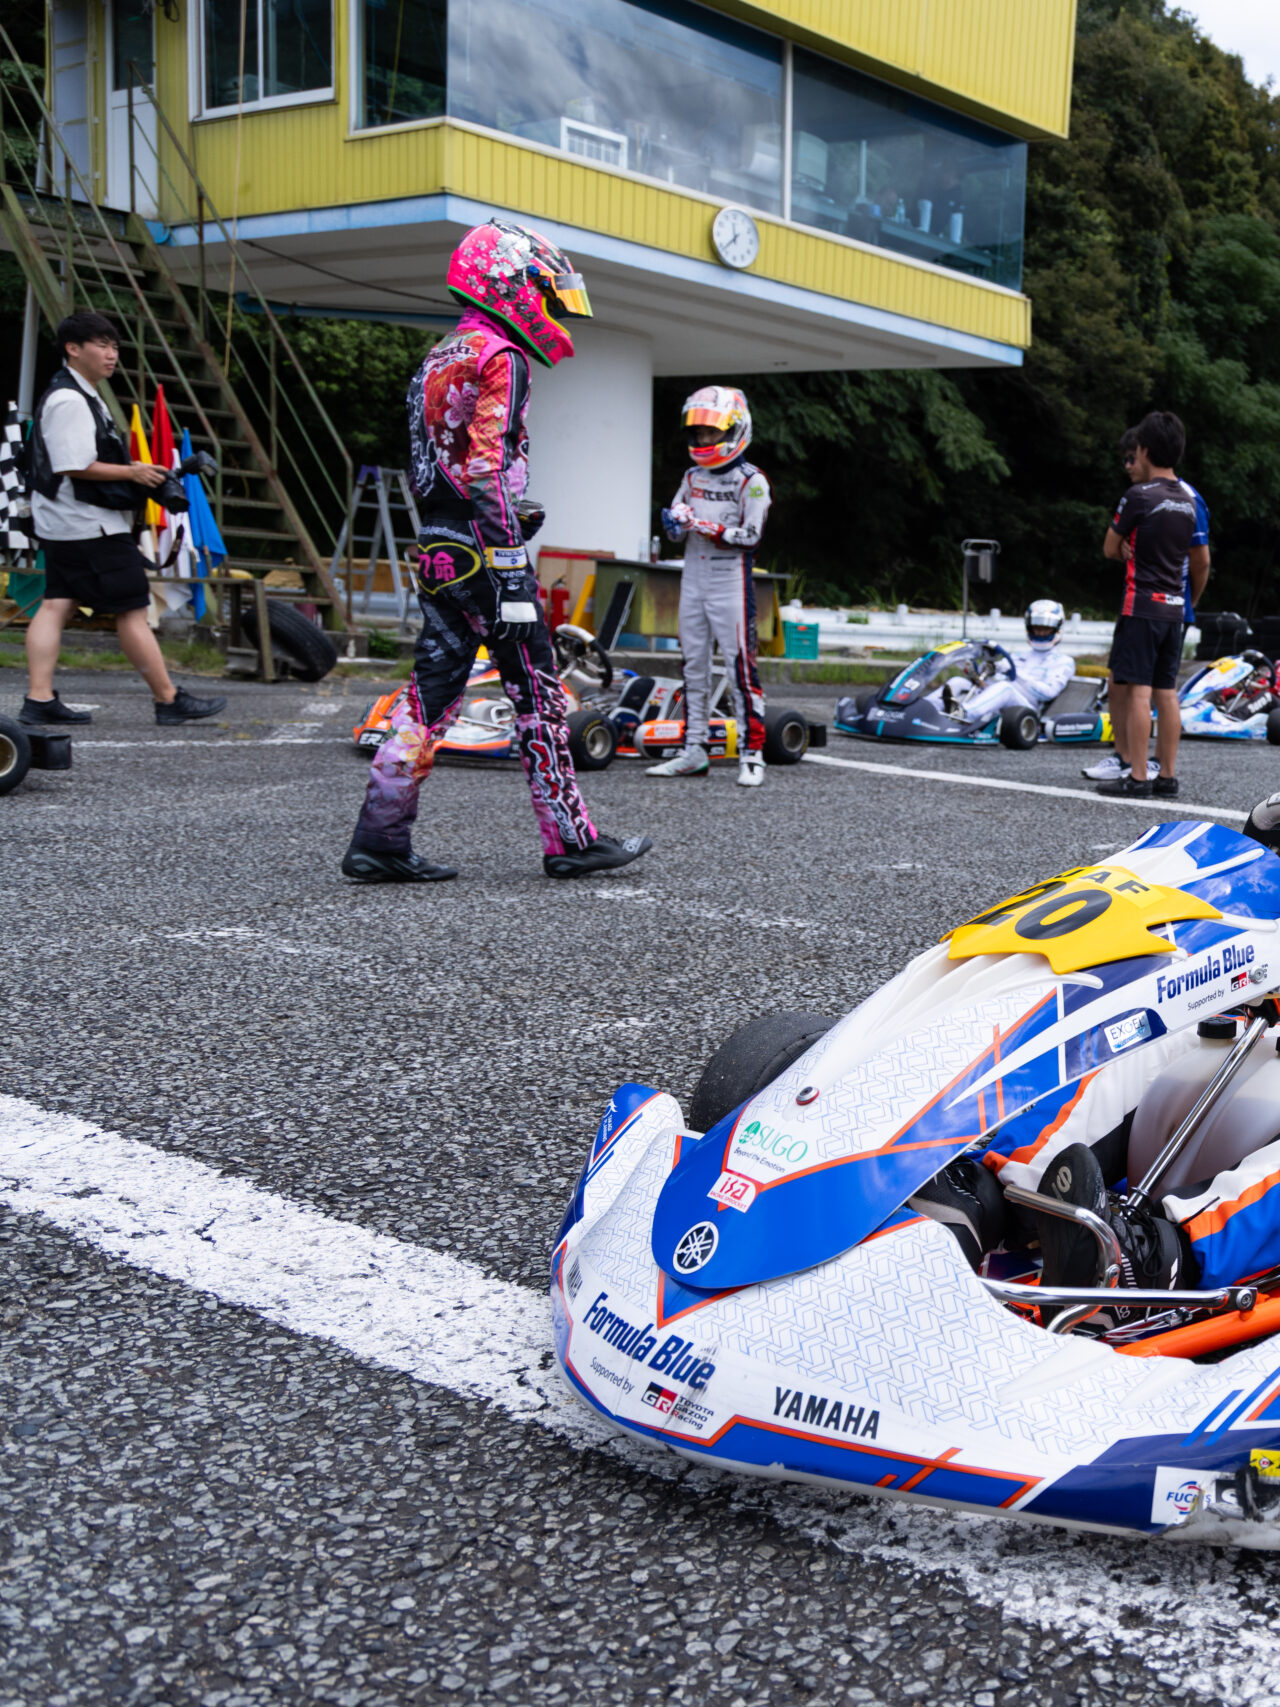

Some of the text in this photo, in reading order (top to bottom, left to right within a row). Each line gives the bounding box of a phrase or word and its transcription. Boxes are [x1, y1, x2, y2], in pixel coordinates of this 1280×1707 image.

[1054, 868, 1151, 894] JAF
[1156, 955, 1221, 1005] Formula
[1222, 944, 1255, 974] Blue
[1187, 990, 1217, 1011] Supported
[752, 1125, 808, 1163] SUGO
[582, 1291, 716, 1391] Formula Blue
[590, 1356, 636, 1396] Supported by
[671, 1410, 704, 1431] Racing
[675, 1402, 708, 1422] GAZOO
[679, 1396, 715, 1417] TOYOTA
[772, 1386, 880, 1440] YAMAHA
